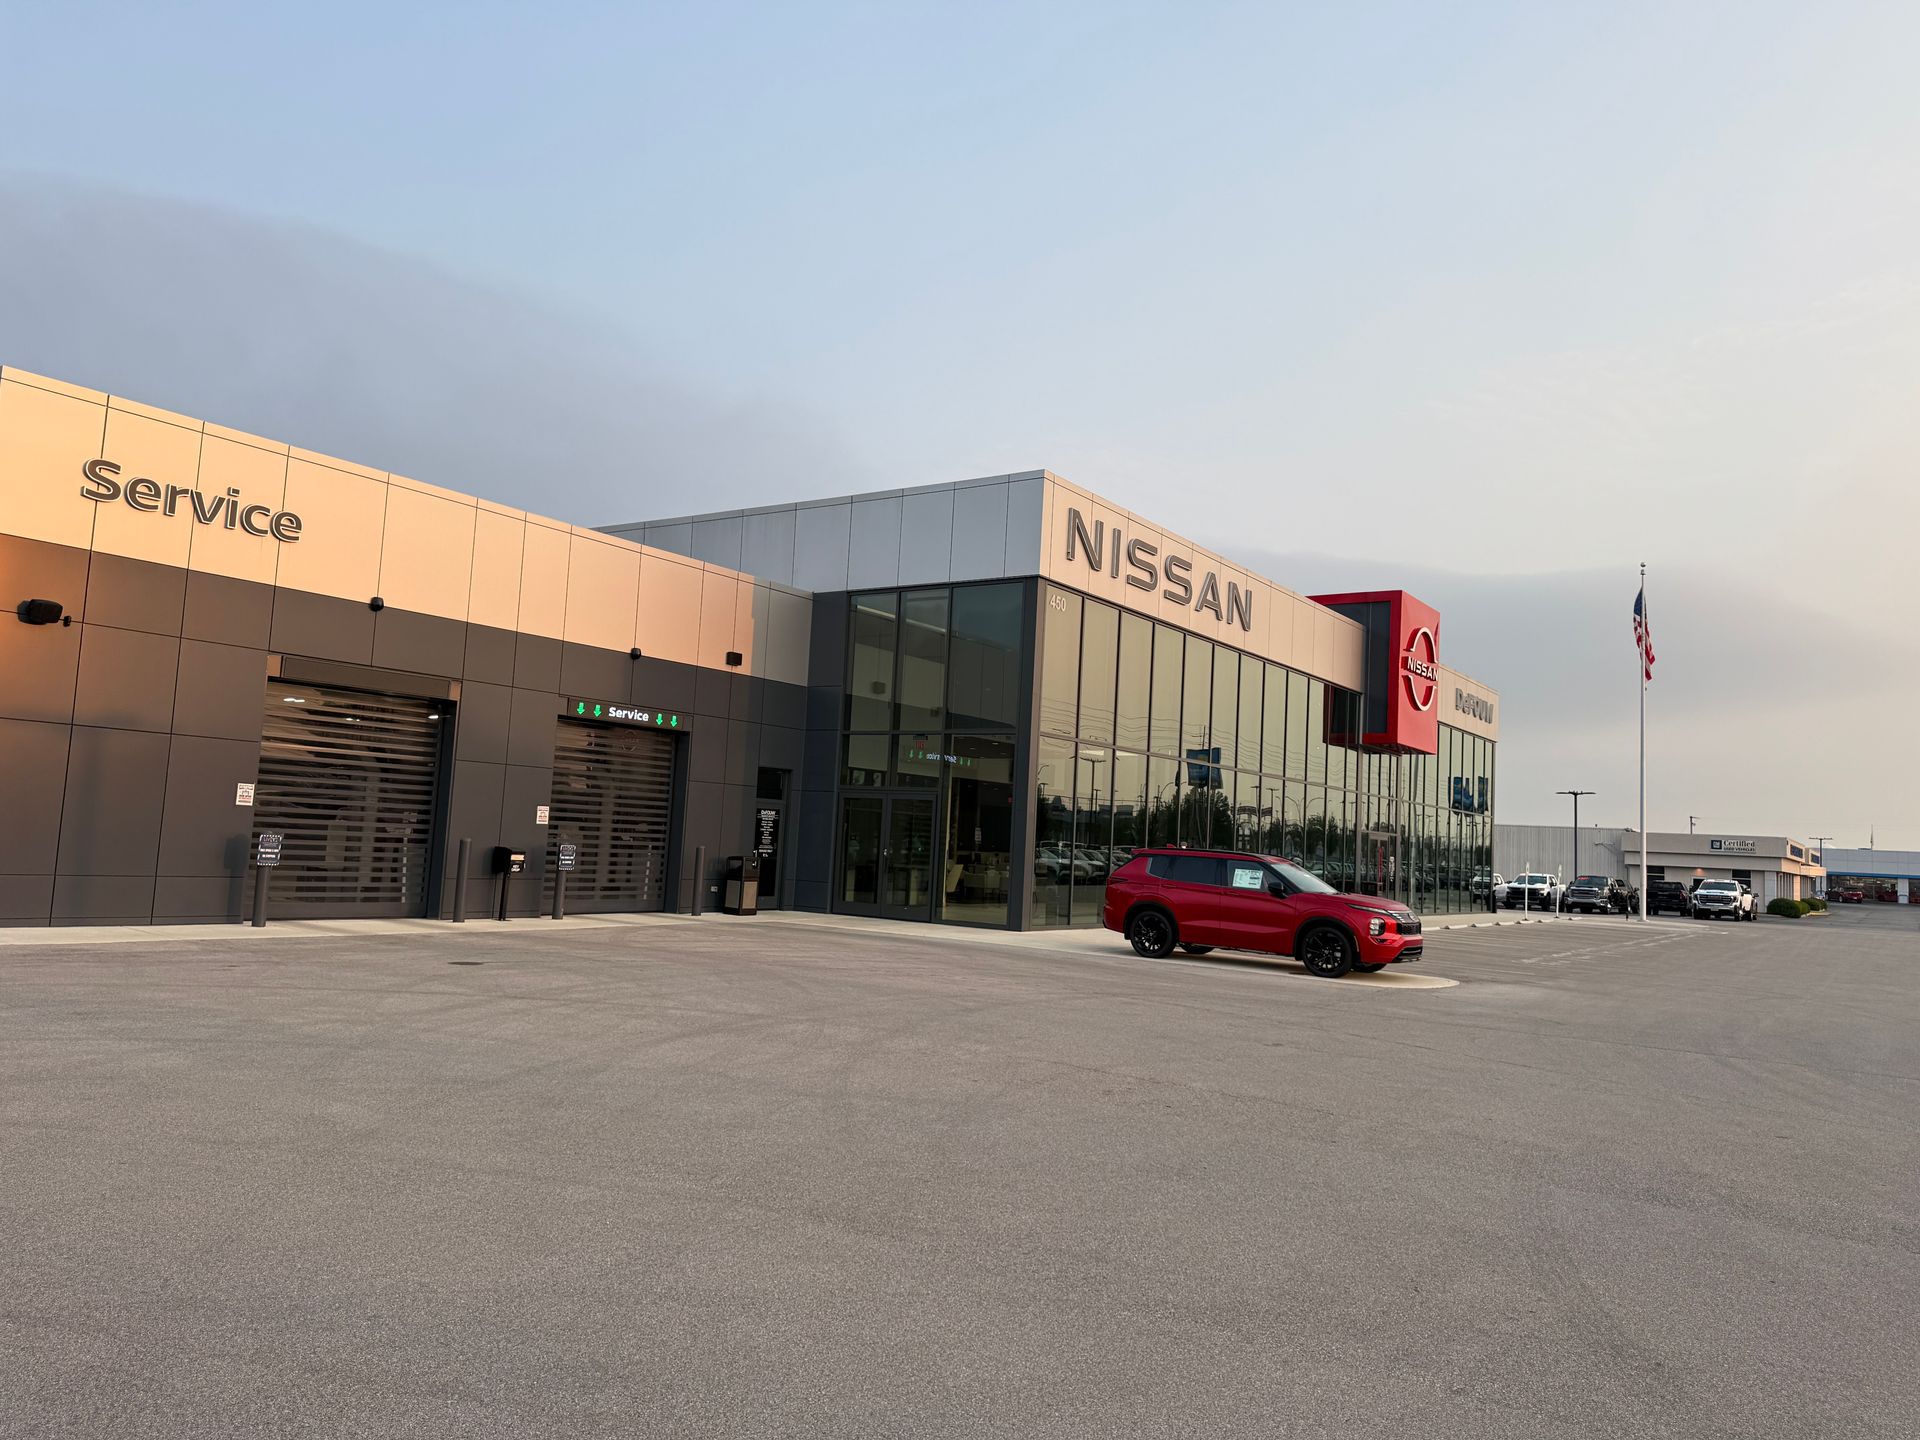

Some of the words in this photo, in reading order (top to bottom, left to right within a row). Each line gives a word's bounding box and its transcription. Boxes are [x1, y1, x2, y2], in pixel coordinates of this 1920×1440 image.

[80, 457, 304, 543] Service
[1065, 507, 1253, 632] NISSAN
[1049, 593, 1067, 613] 450
[1407, 655, 1439, 682] NISSAN
[608, 706, 650, 722] Service
[1723, 839, 1756, 848] Certified
